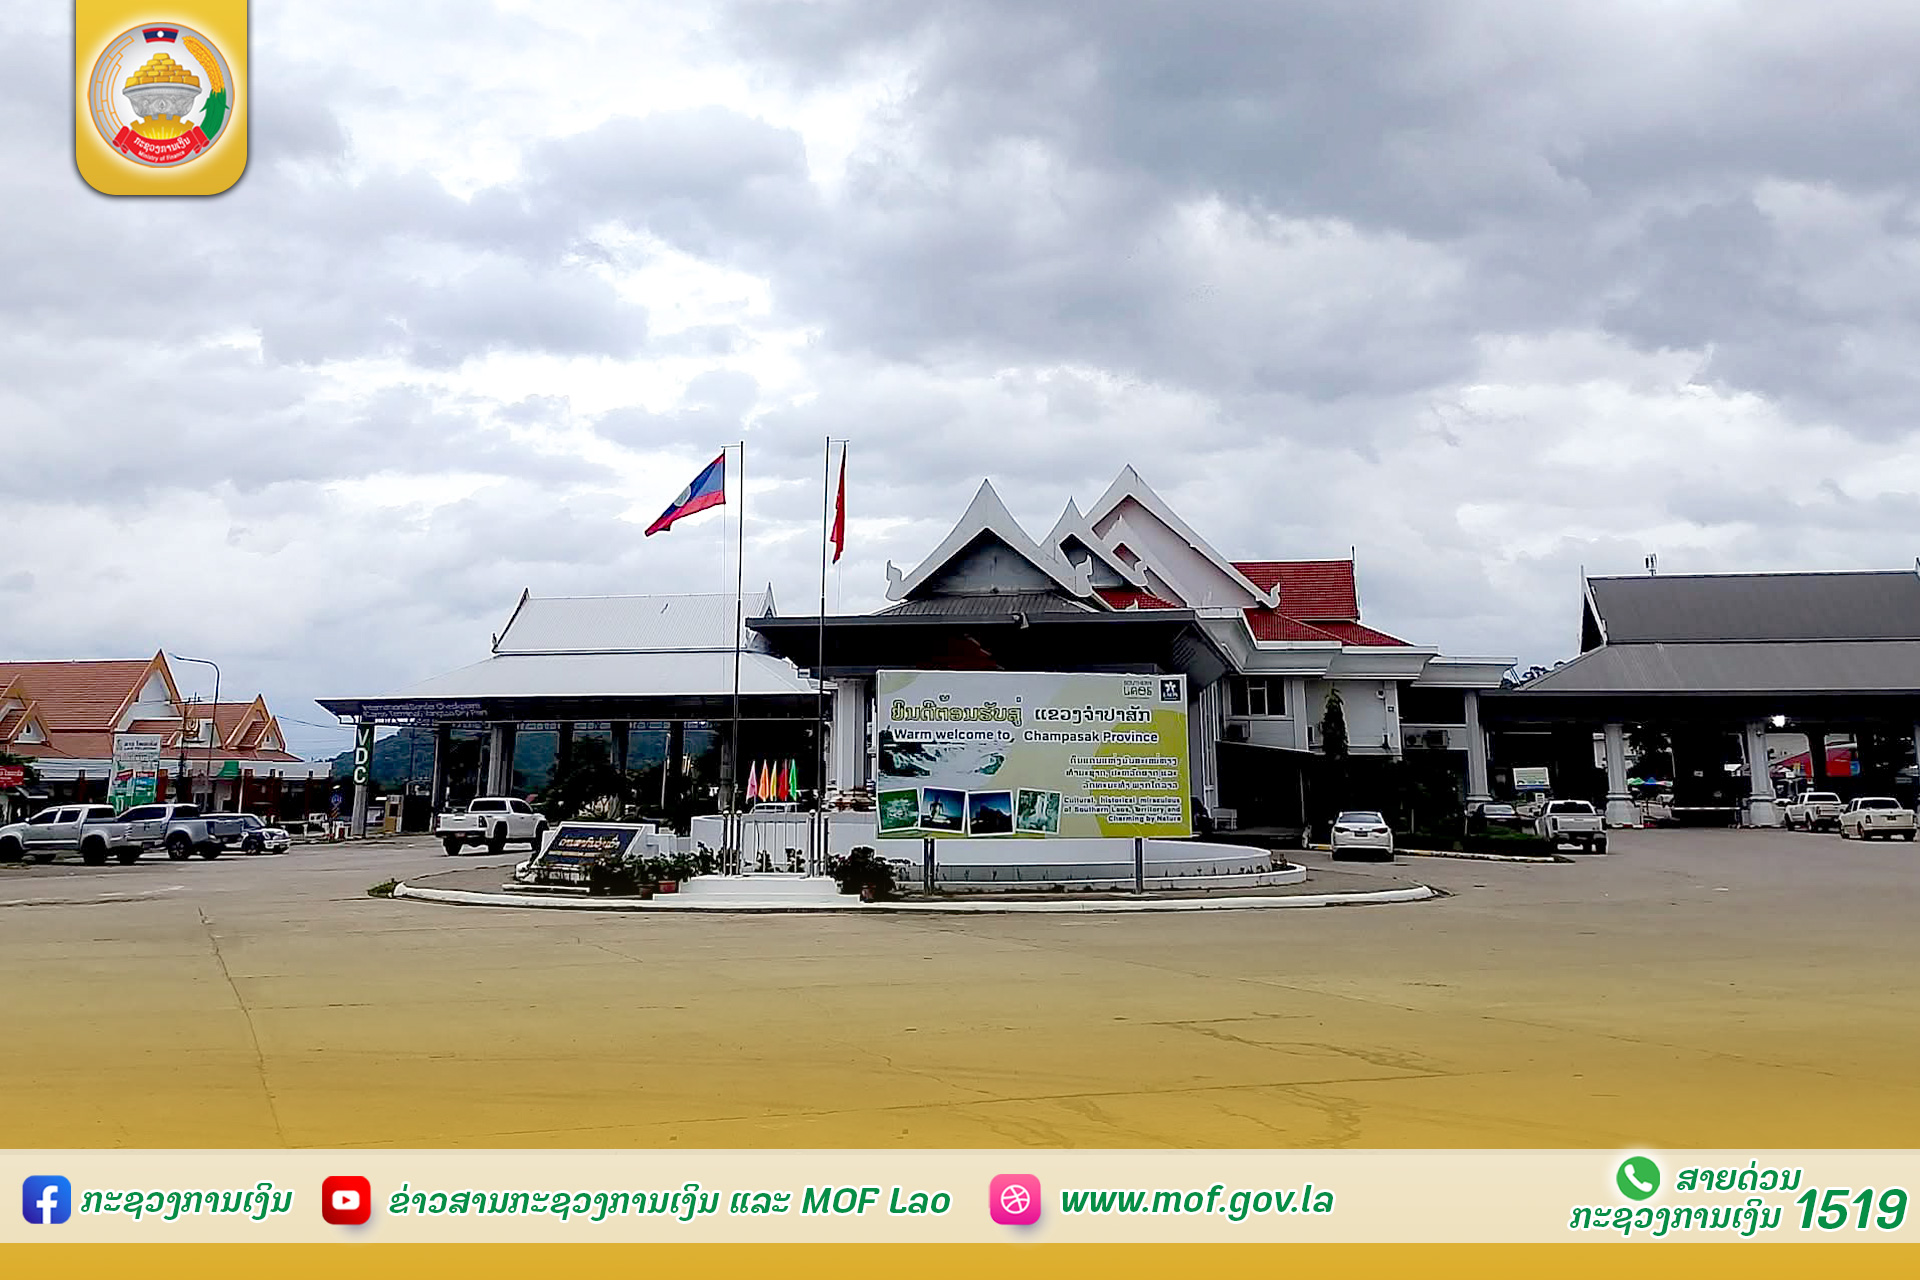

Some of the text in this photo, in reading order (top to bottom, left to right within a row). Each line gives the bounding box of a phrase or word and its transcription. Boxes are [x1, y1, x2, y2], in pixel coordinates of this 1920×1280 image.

[894, 730, 932, 741] Warm
[936, 730, 993, 742] welcome
[1024, 731, 1099, 744] Champasak
[1104, 732, 1158, 742] Province
[353, 728, 370, 784] VDC
[1167, 806, 1181, 814] and
[1108, 815, 1144, 823] Charming
[1146, 815, 1155, 824] by
